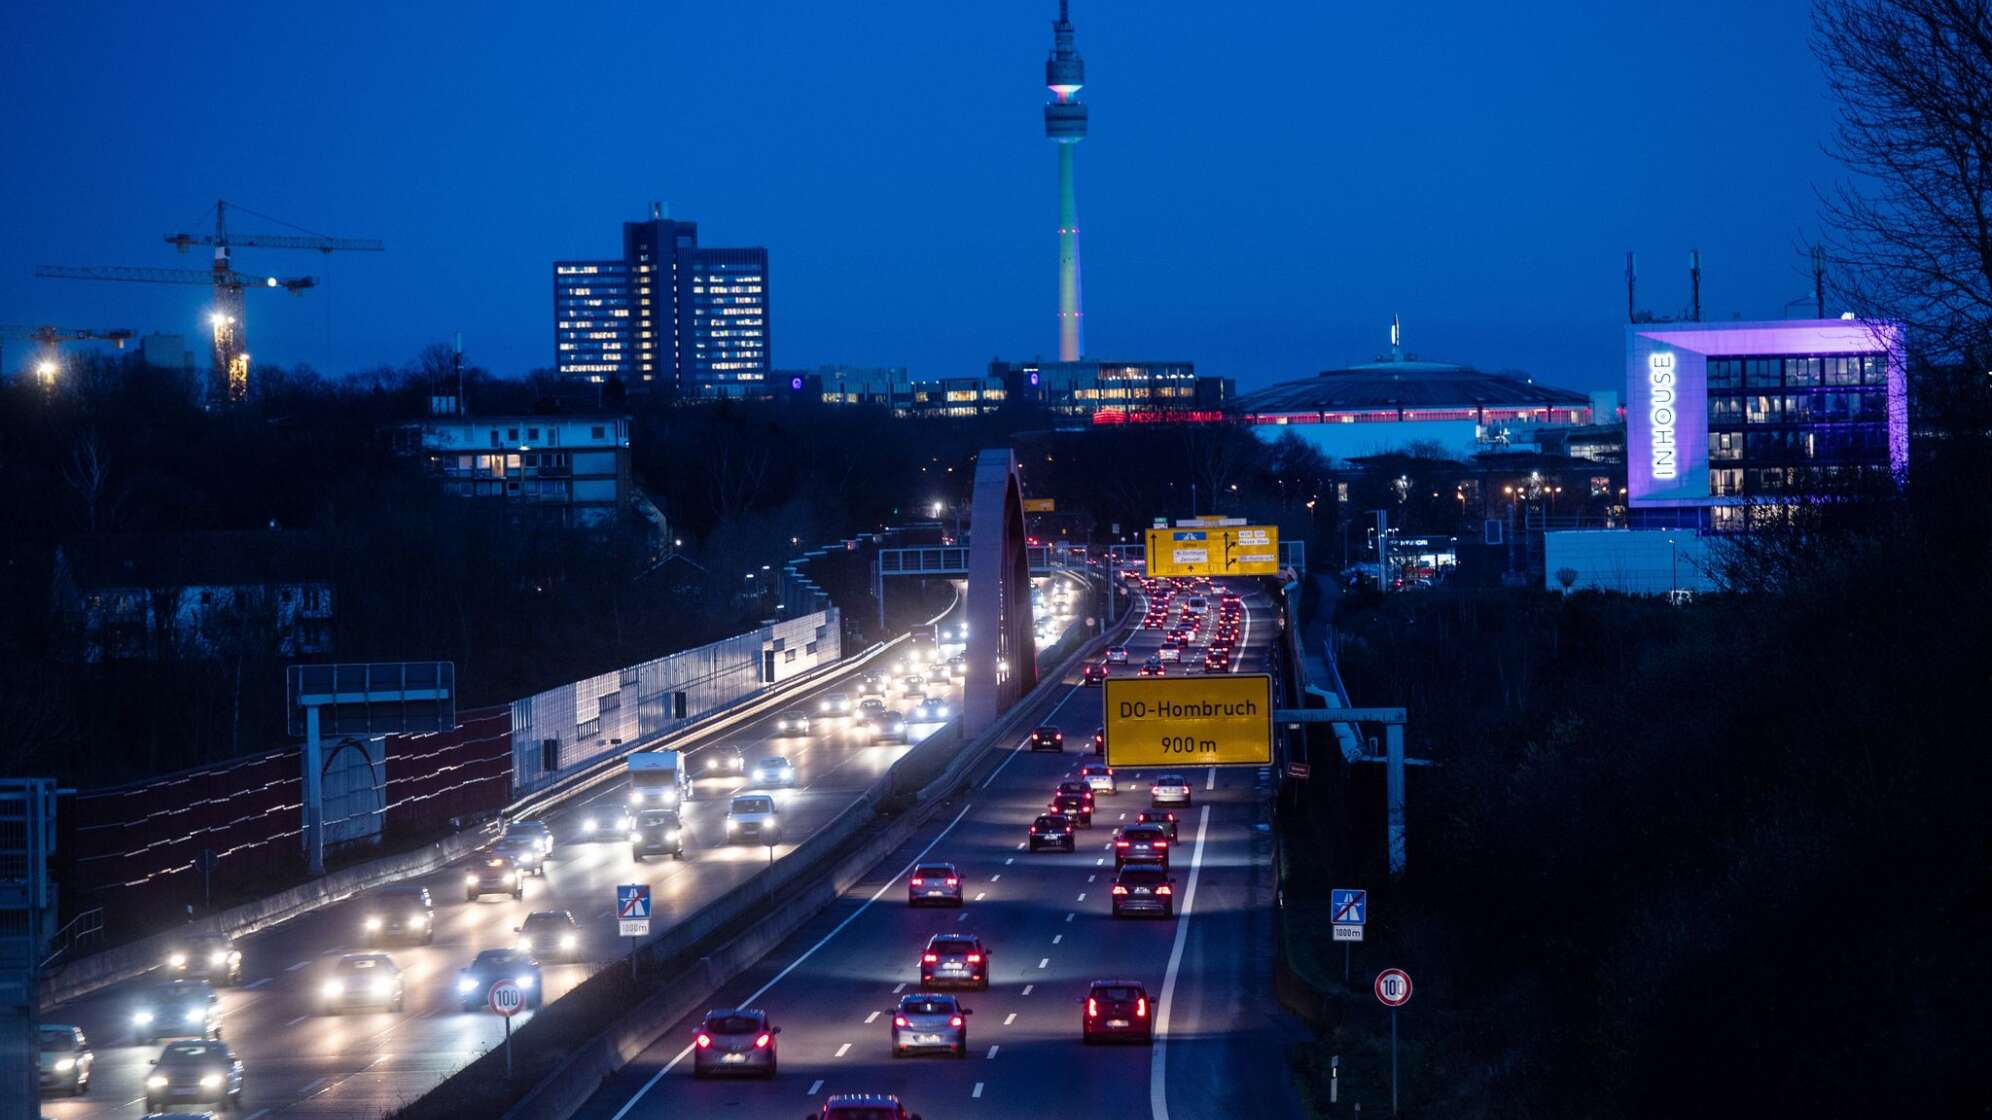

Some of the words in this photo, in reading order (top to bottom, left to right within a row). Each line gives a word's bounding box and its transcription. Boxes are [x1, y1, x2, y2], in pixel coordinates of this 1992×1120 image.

[1652, 355, 1674, 476] INHOUSE
[1120, 700, 1257, 718] DO-Hombruch
[1161, 736, 1195, 753] 900
[1199, 739, 1217, 753] m
[1383, 979, 1405, 996] 100
[496, 989, 518, 1007] 100
